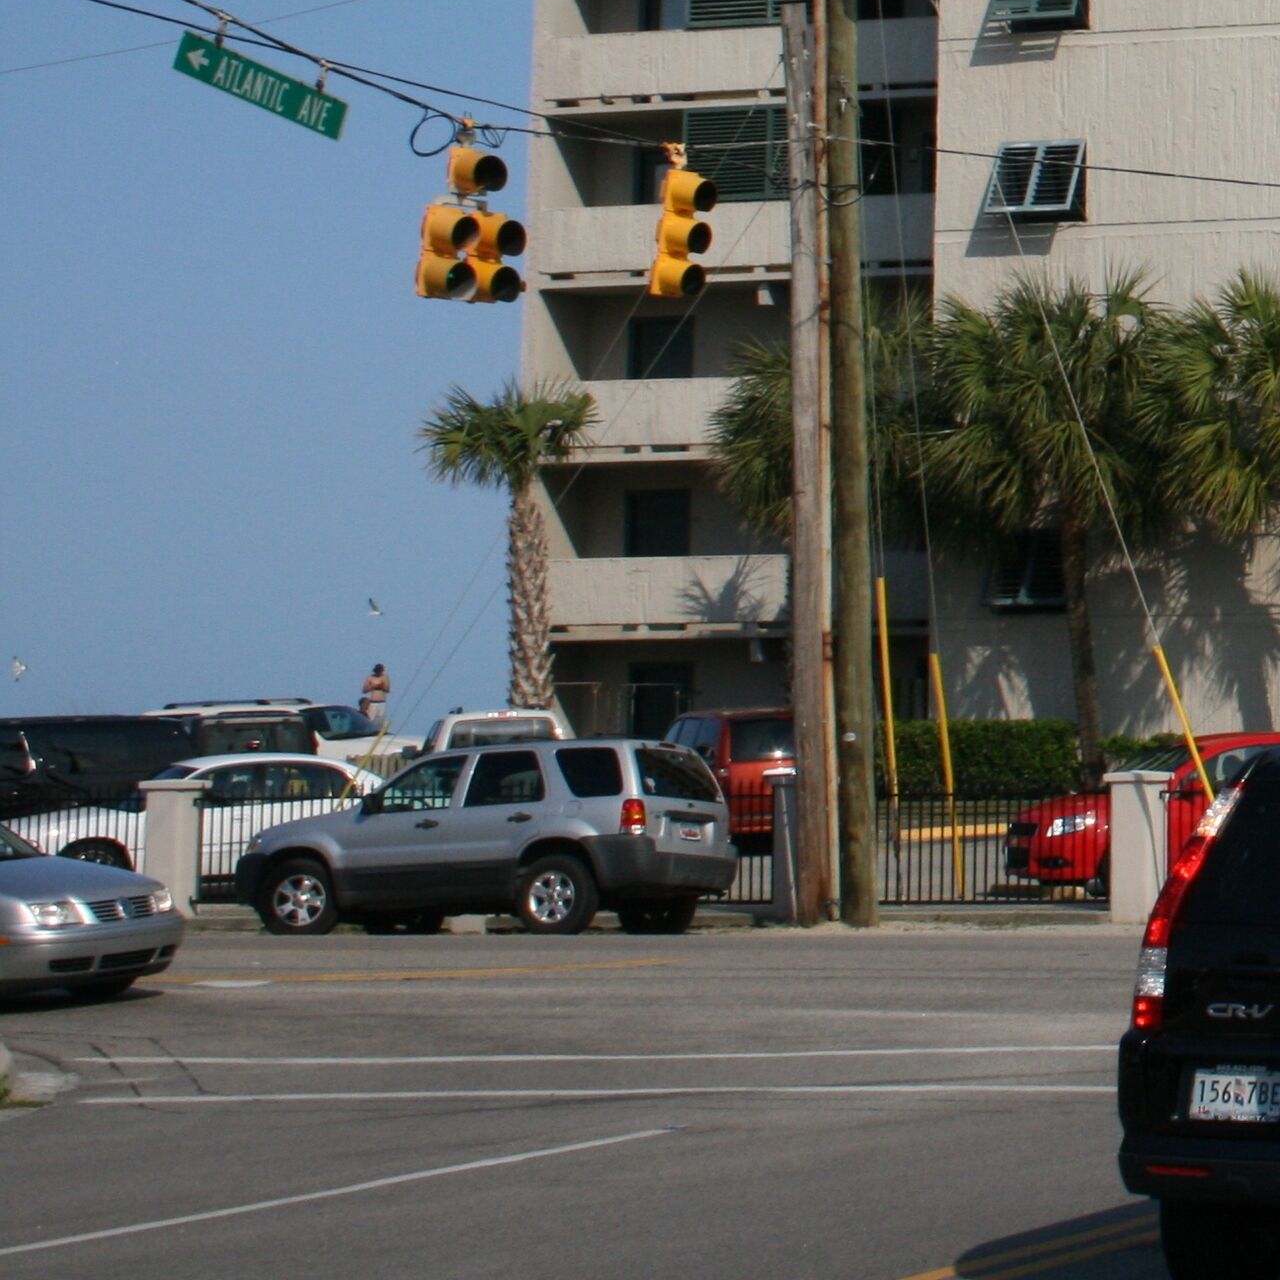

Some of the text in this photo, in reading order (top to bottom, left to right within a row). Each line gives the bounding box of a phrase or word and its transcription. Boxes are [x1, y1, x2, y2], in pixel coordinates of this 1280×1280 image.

[212, 56, 333, 131] ATLANTIC AVE
[1206, 1002, 1273, 1018] CR-V
[1199, 1080, 1232, 1103] 156
